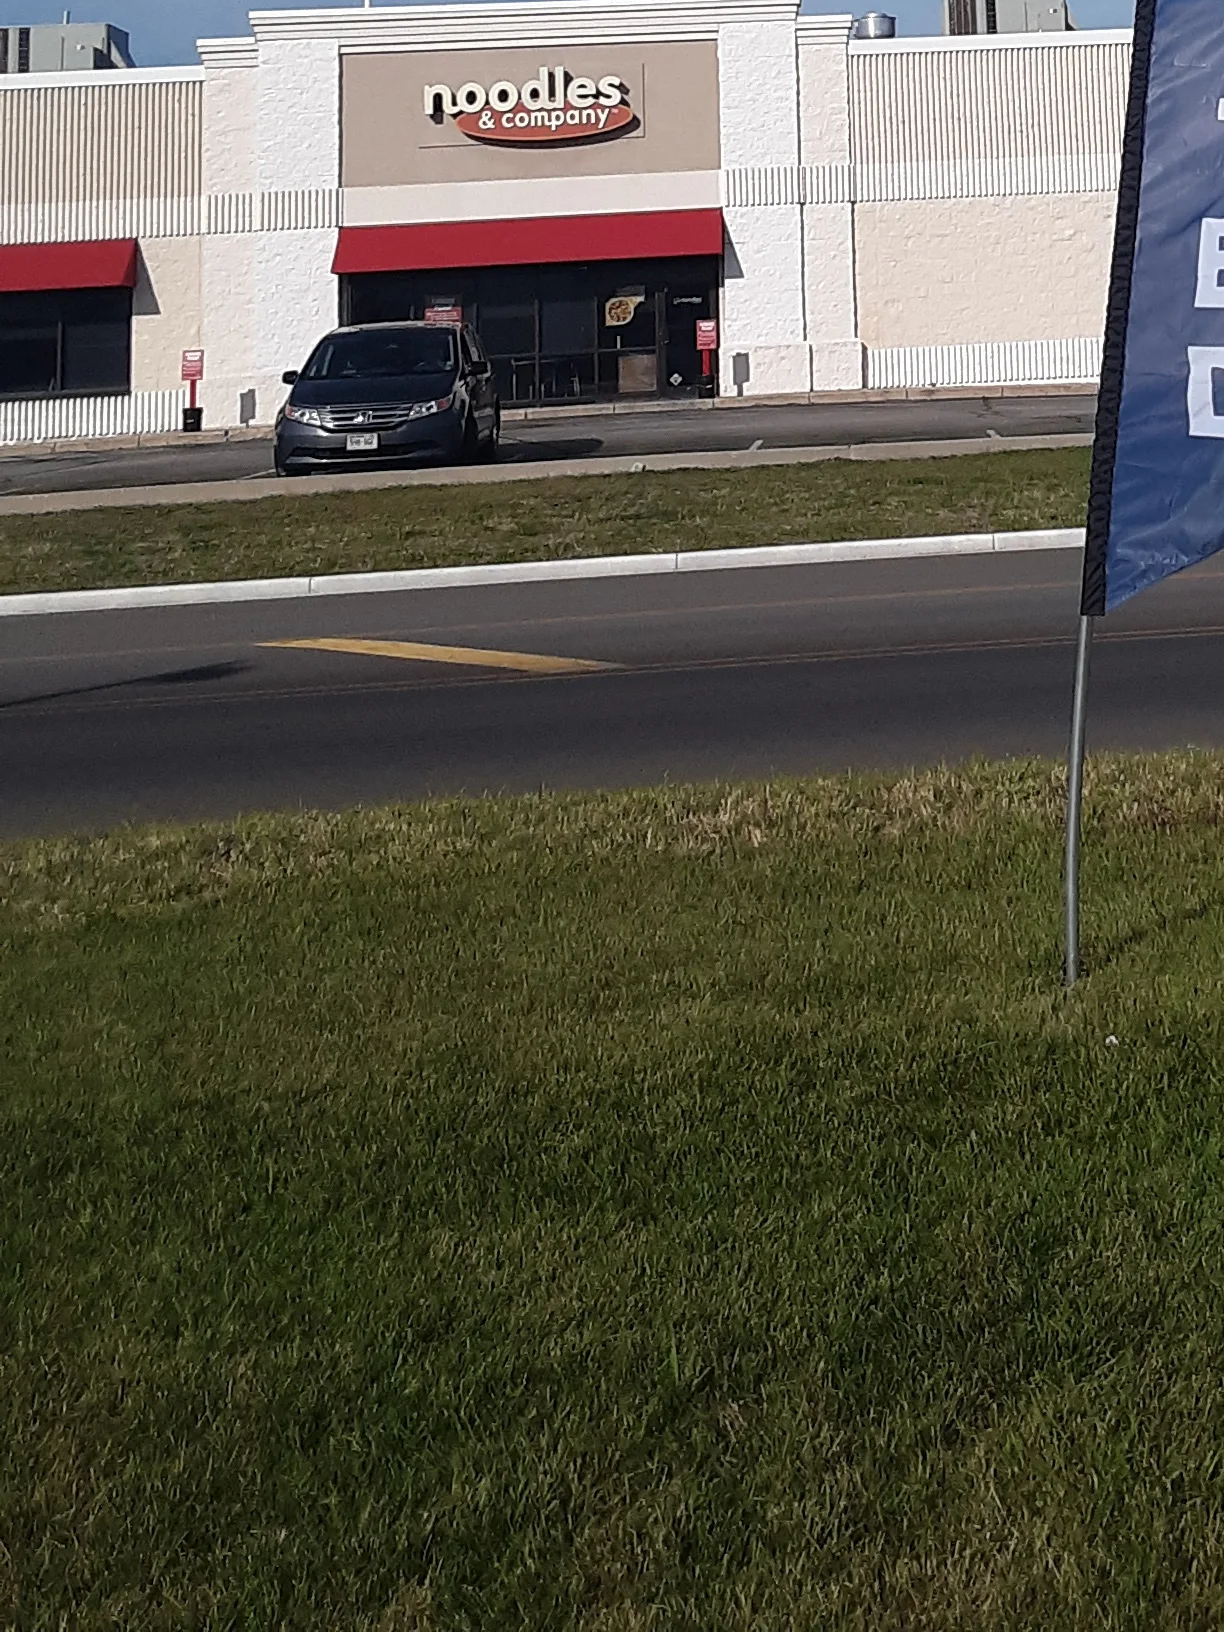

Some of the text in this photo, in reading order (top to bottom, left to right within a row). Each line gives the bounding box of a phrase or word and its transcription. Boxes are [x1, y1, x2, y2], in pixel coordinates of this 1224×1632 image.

[423, 66, 623, 115] noodles
[478, 108, 609, 131] & company
